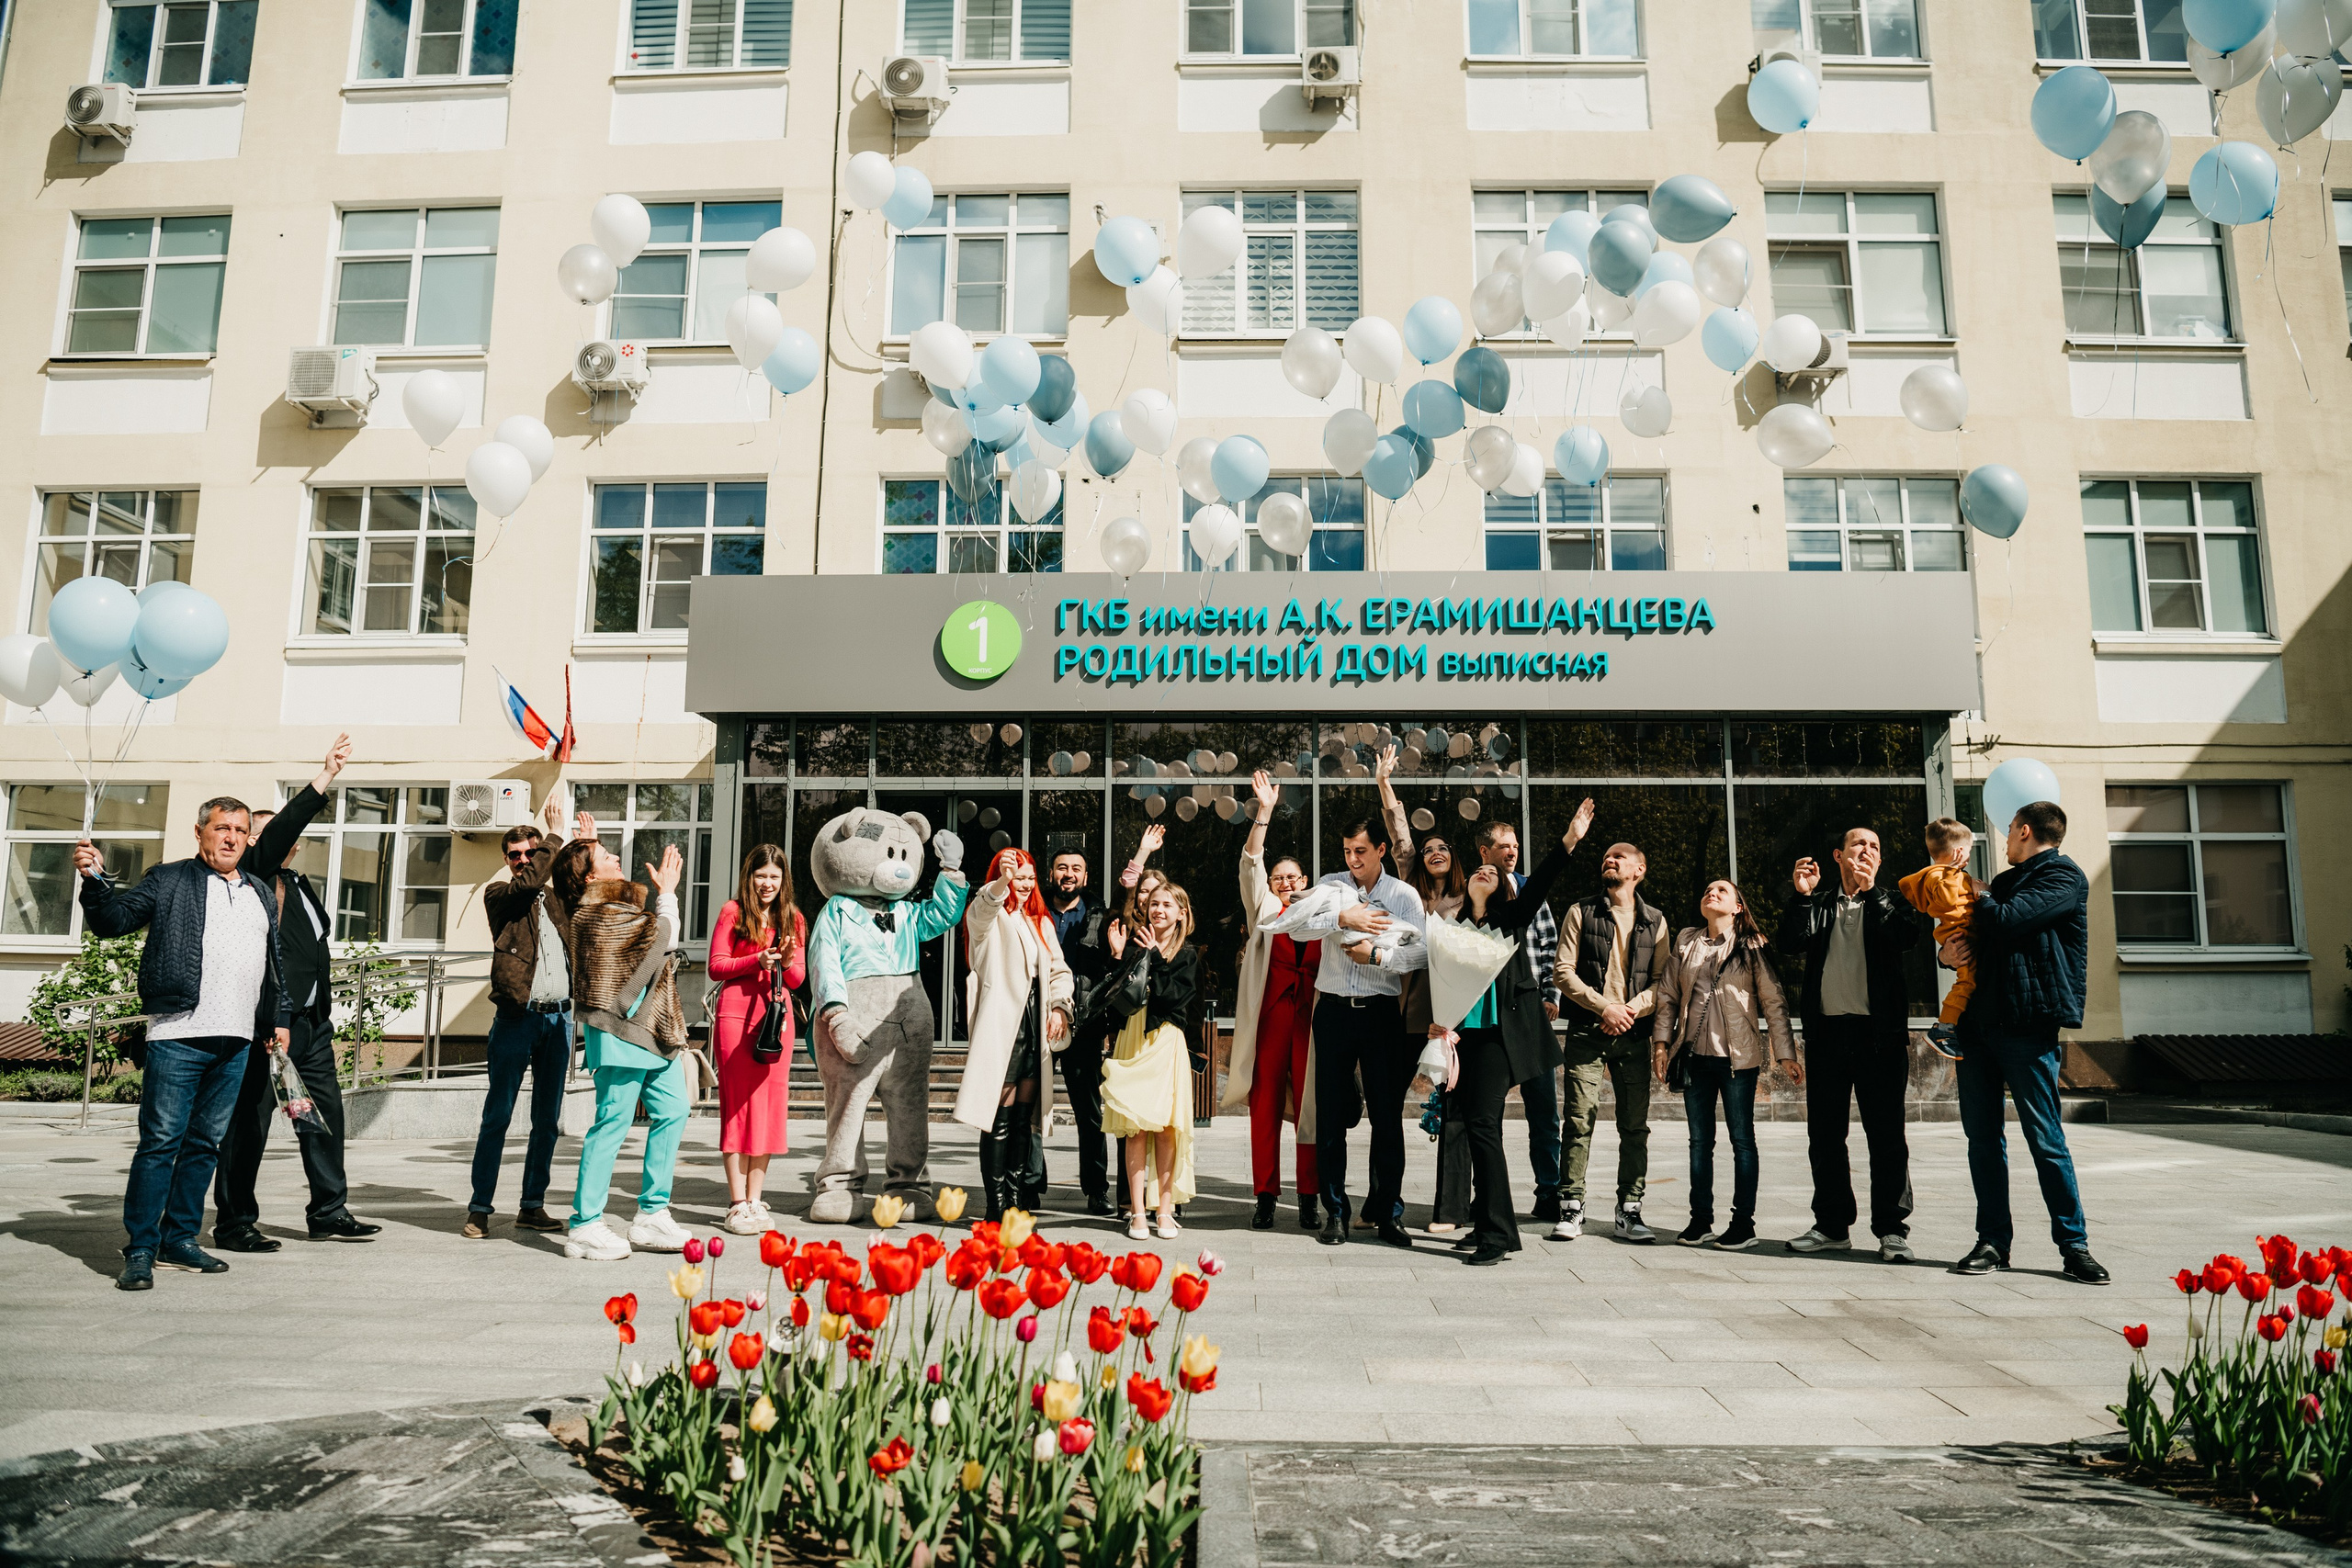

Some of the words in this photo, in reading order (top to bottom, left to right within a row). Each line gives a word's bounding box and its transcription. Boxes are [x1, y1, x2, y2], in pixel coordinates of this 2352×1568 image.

[1059, 598, 1131, 630] ГКБ
[1144, 605, 1269, 629] имени
[1281, 597, 1354, 629] А.К.
[1365, 596, 1716, 634] ЕРАМИШАНЦЕВА
[968, 616, 988, 662] 1
[1058, 634, 1323, 682] РОДИЛЬНЫЙ
[1337, 643, 1428, 682] ДОМ
[1442, 651, 1609, 675] ВЫПИСНАЯ
